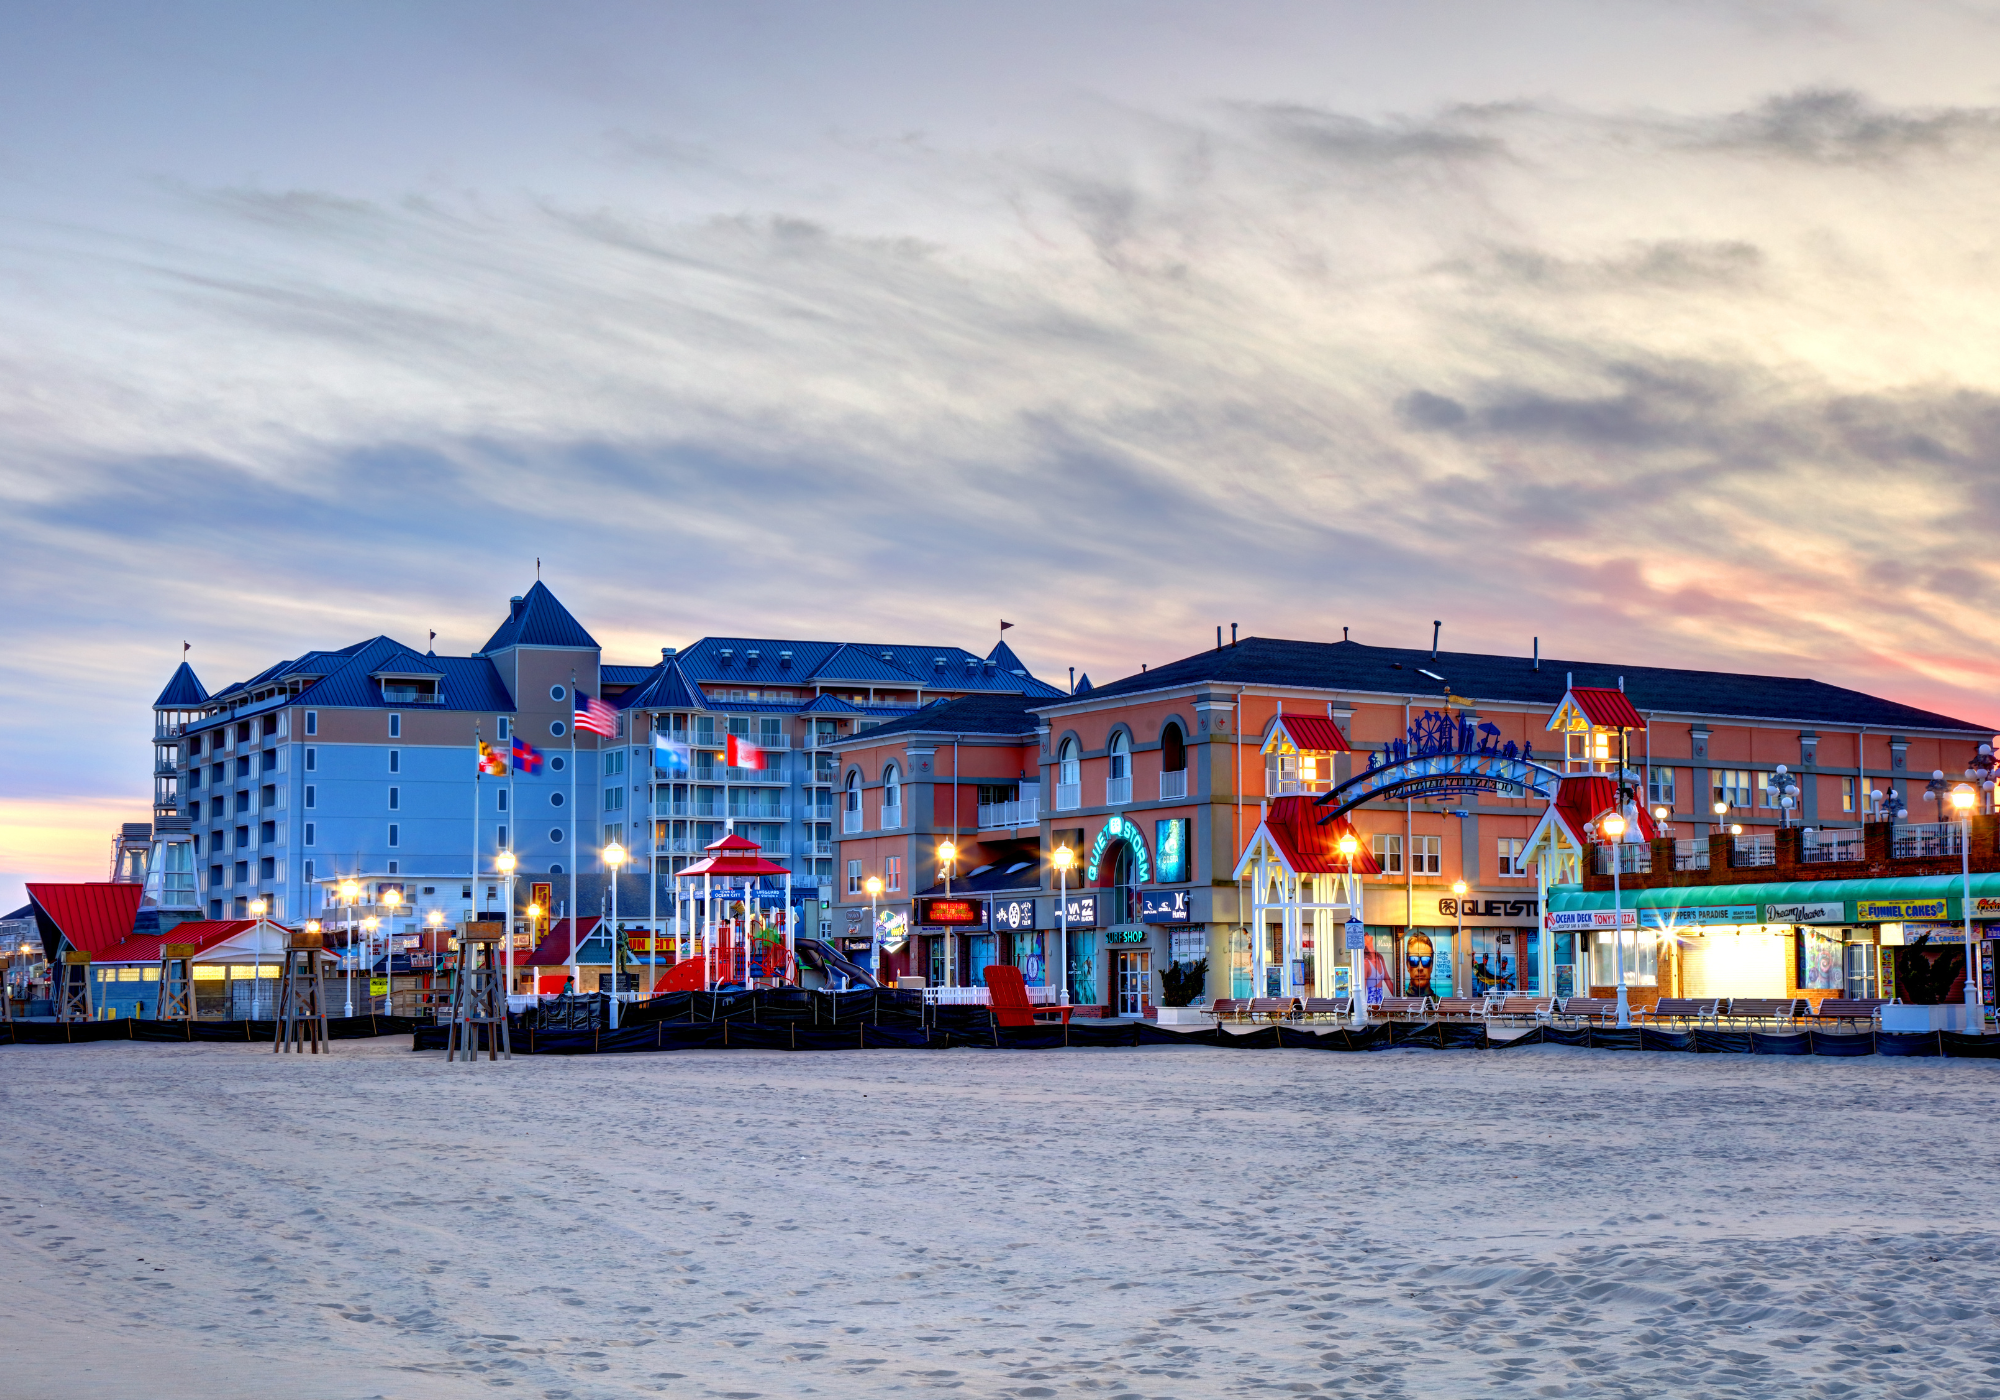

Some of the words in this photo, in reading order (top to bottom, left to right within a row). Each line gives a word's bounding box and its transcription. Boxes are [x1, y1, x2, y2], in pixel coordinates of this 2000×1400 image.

[1088, 824, 1110, 881] QUIET
[1124, 822, 1150, 882] STORM
[1172, 910, 1187, 919] Hurley
[1698, 910, 1728, 919] PARADISE
[1766, 904, 1797, 921] Dream
[1793, 906, 1826, 921] Weaver
[1868, 906, 1904, 917] FUNNEL
[1905, 905, 1937, 917] CAKES
[1555, 914, 1575, 923] OCEAN
[1577, 913, 1592, 922] DECK
[1594, 914, 1616, 924] TONY'S
[1620, 914, 1635, 924] IZZA
[1105, 932, 1122, 944] SURF
[1123, 931, 1143, 943] SHOP
[628, 939, 645, 950] UN
